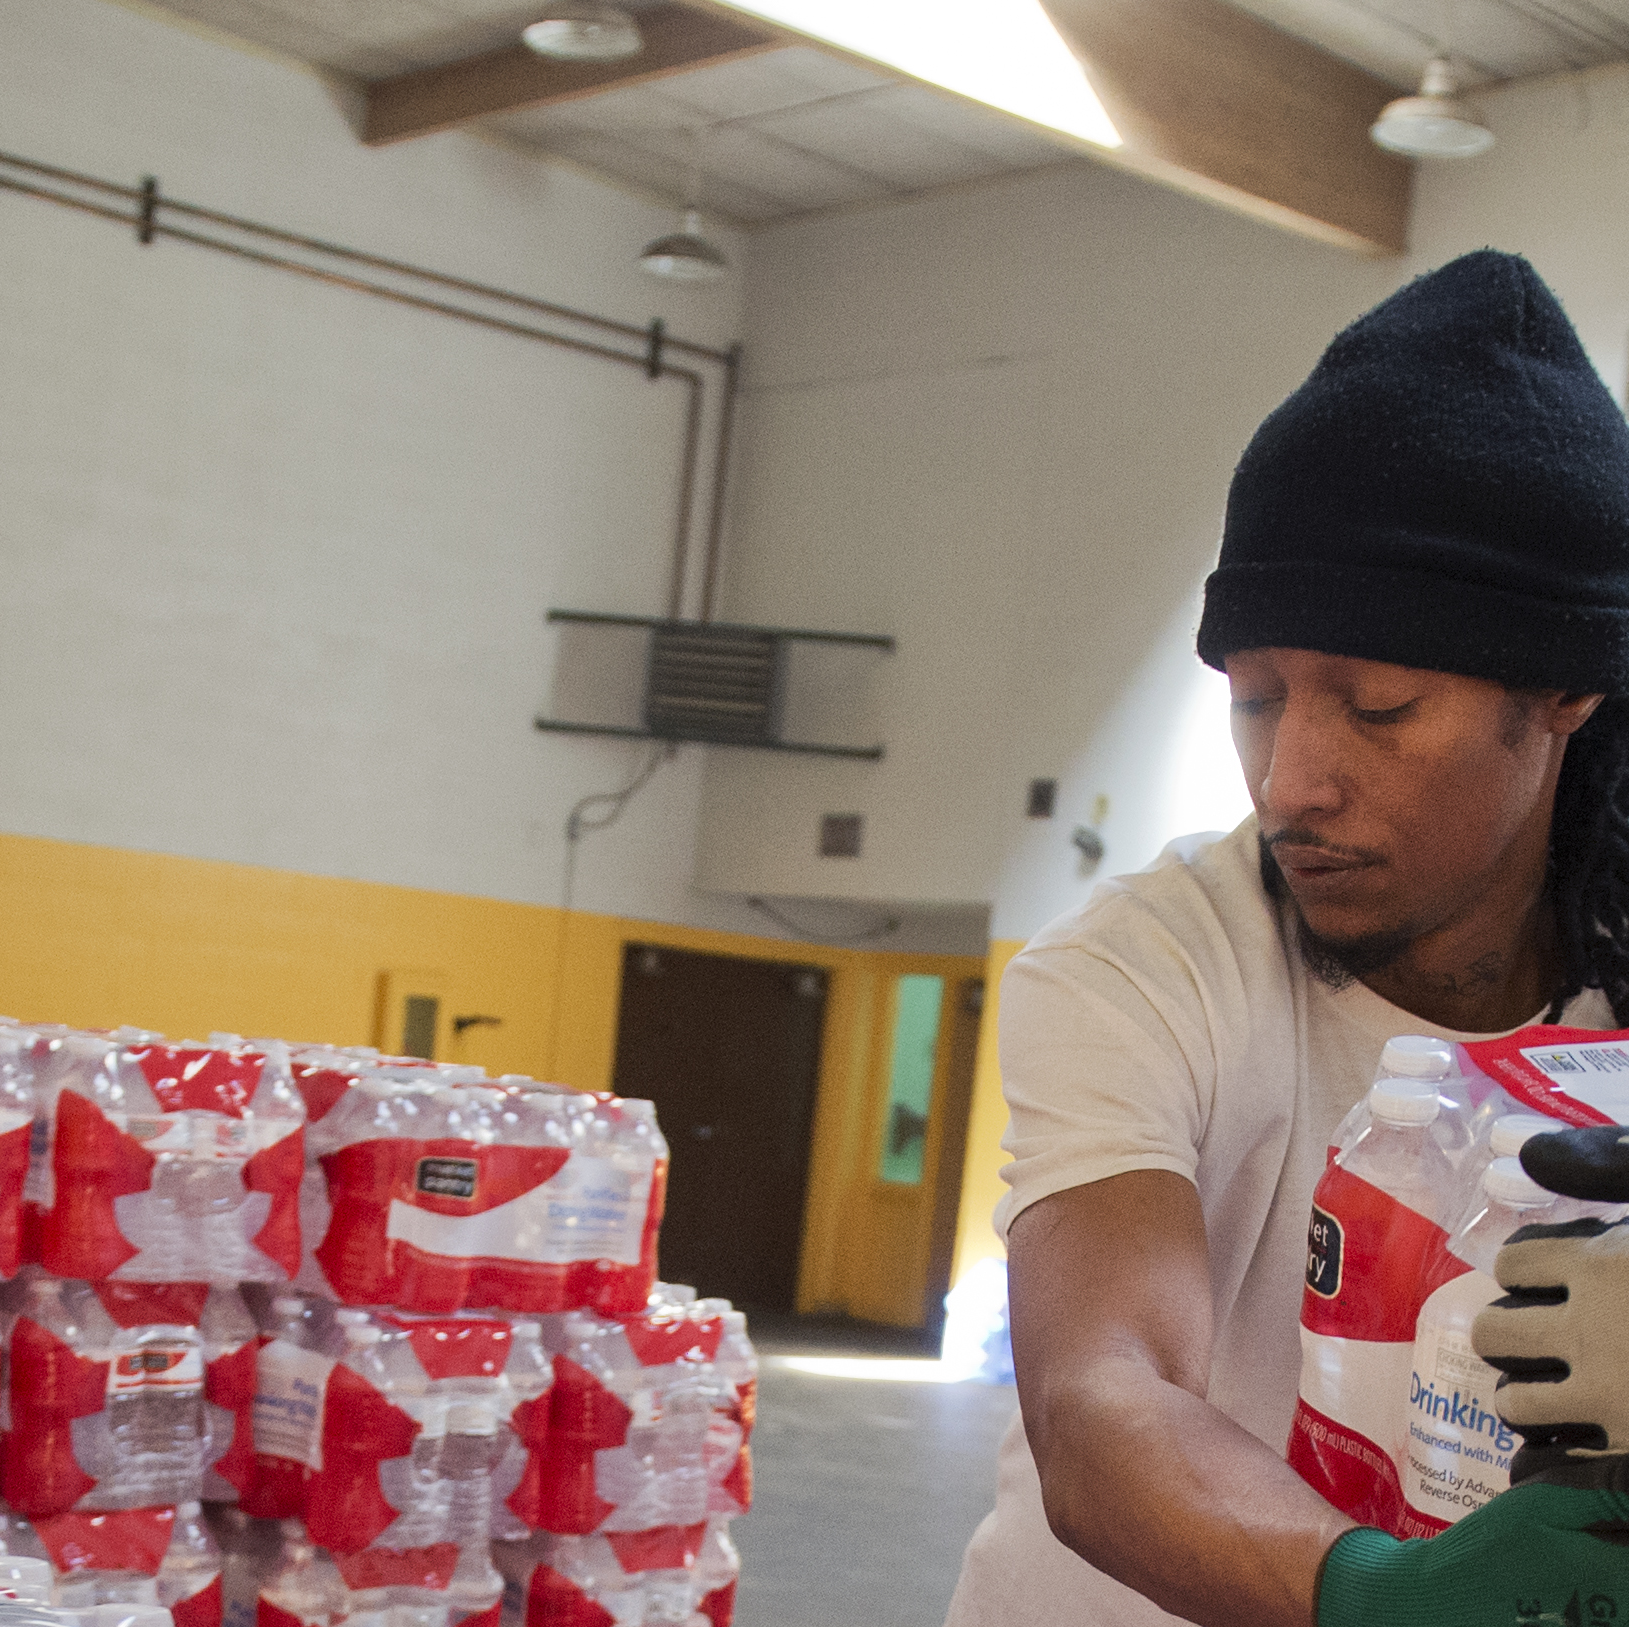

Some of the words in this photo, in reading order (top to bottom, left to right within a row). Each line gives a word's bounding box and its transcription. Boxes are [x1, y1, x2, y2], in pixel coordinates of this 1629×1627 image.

[1410, 1371, 1516, 1452] Drinking
[1410, 1421, 1461, 1454] Enhanced
[1464, 1445, 1493, 1465] with
[1420, 1478, 1460, 1505] Reverse
[1449, 1471, 1464, 1491] by
